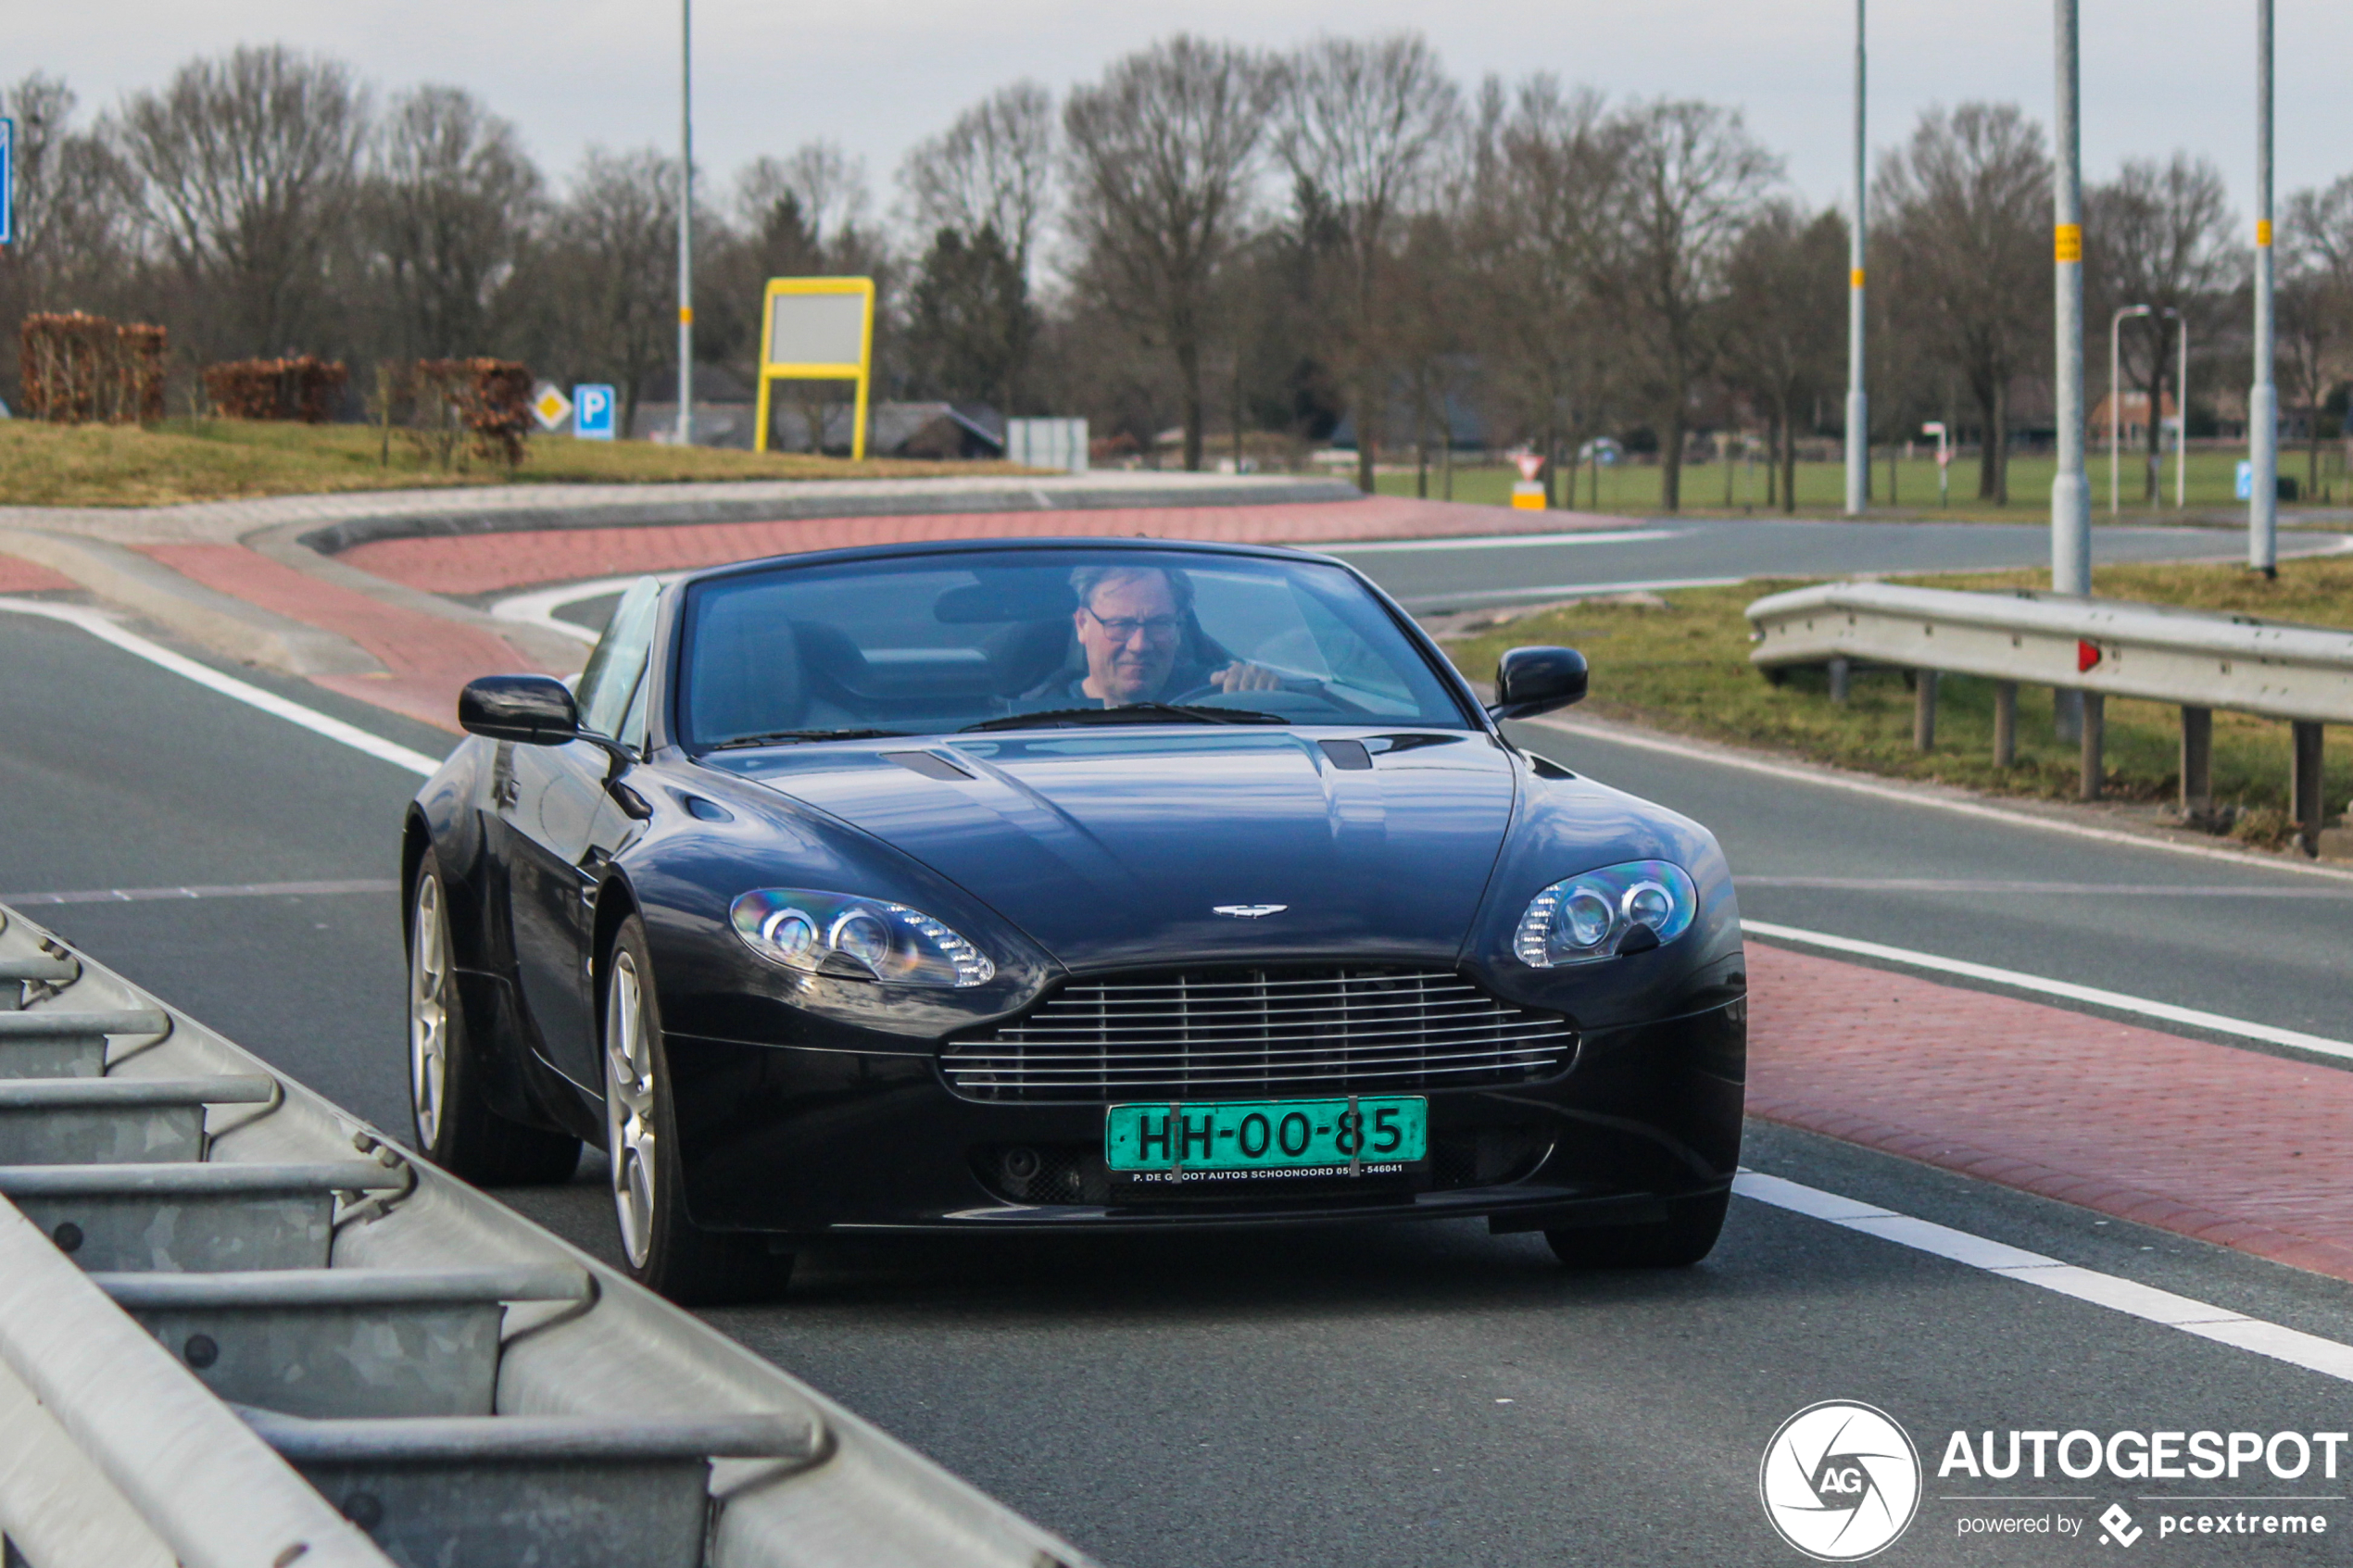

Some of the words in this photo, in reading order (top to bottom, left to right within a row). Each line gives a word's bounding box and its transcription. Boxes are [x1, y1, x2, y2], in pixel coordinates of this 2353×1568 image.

[584, 391, 606, 422] P
[1164, 1172, 1206, 1181] GOOT
[1208, 1171, 1248, 1180] AUTOS
[1251, 1167, 1334, 1178] SCHOONOORD
[1366, 1164, 1403, 1173] 546041
